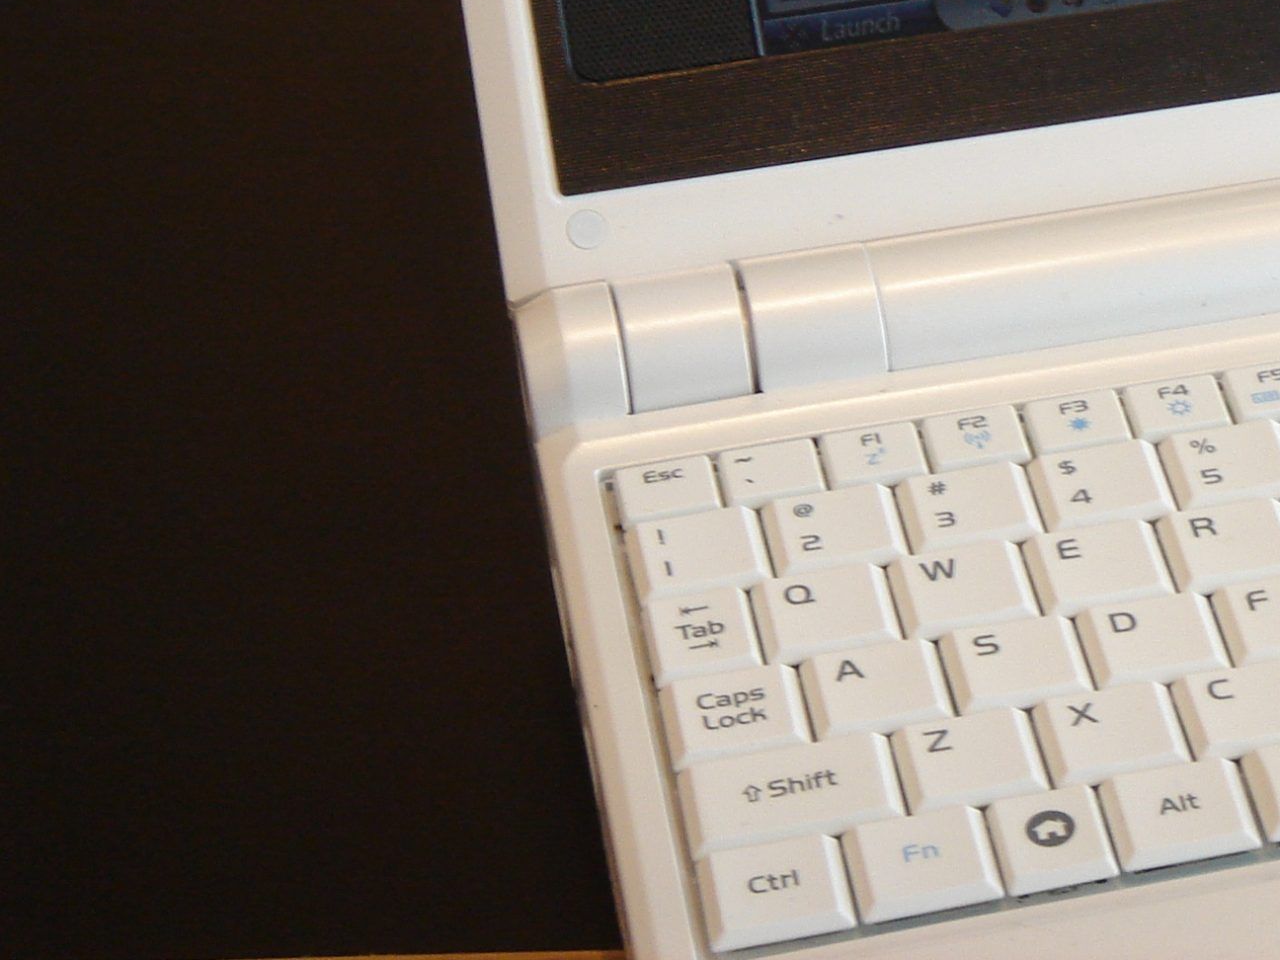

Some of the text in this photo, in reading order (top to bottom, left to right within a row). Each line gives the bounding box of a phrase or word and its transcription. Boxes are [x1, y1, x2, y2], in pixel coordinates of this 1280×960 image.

[820, 13, 902, 42] Launch
[1156, 383, 1190, 400] F4
[1057, 399, 1090, 416] F3
[956, 414, 991, 431] F2
[859, 431, 883, 447] F1
[641, 466, 686, 485] Esc
[1199, 467, 1225, 486] 5
[1069, 487, 1094, 505] 4
[933, 509, 958, 529] 3
[1187, 515, 1219, 540] R
[799, 533, 824, 553] 2
[1054, 537, 1083, 562] E
[918, 557, 957, 583] W
[782, 582, 818, 607] Q
[1245, 589, 1270, 613] F
[674, 619, 727, 641] Tab
[1107, 610, 1138, 634] D
[971, 633, 1002, 658] S
[834, 658, 867, 683] A
[695, 686, 767, 712] Caps
[1205, 676, 1236, 701] C
[700, 705, 769, 732] Lock
[1066, 700, 1101, 728] X
[921, 728, 954, 755] Z
[766, 768, 840, 799] Shift
[1158, 791, 1203, 817] Alt
[901, 842, 941, 864] Fn
[746, 868, 800, 897] Ctrl
